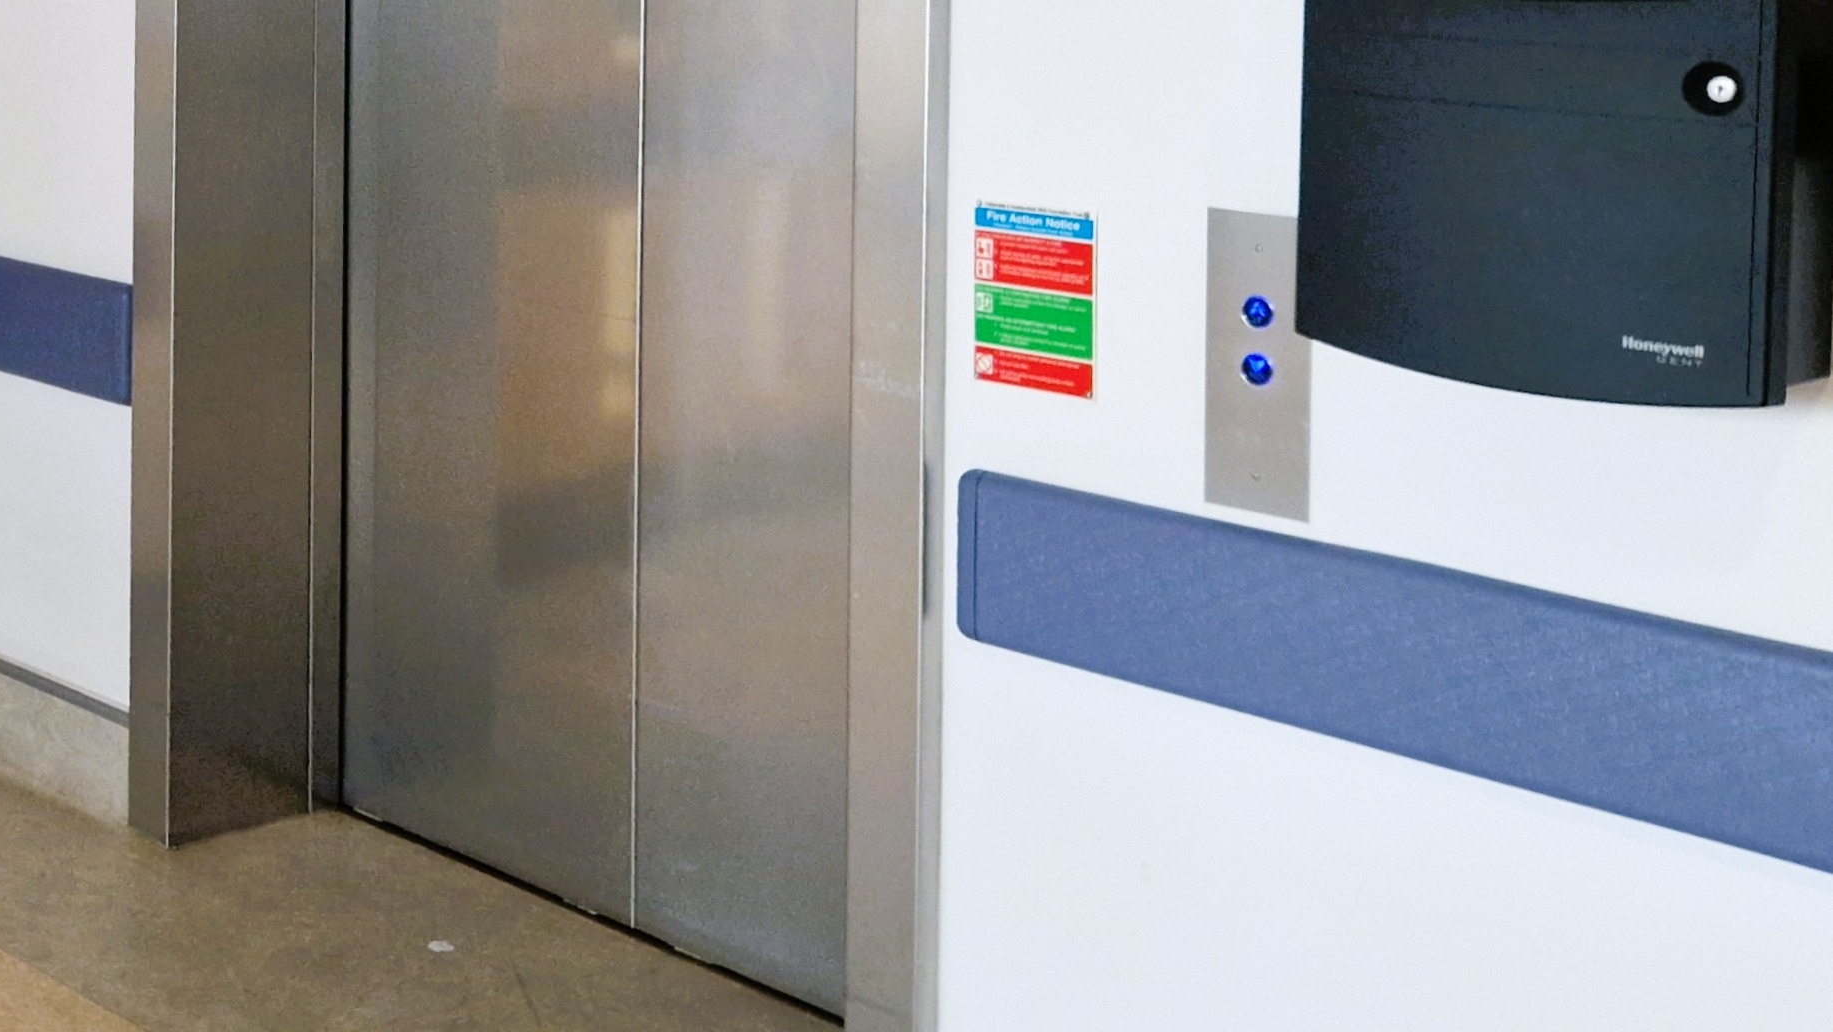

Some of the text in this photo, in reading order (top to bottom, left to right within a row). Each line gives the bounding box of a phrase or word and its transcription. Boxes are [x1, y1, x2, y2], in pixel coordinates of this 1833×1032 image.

[986, 210, 1080, 231] Fire Action Notice
[1622, 335, 1705, 359] Honeywell
